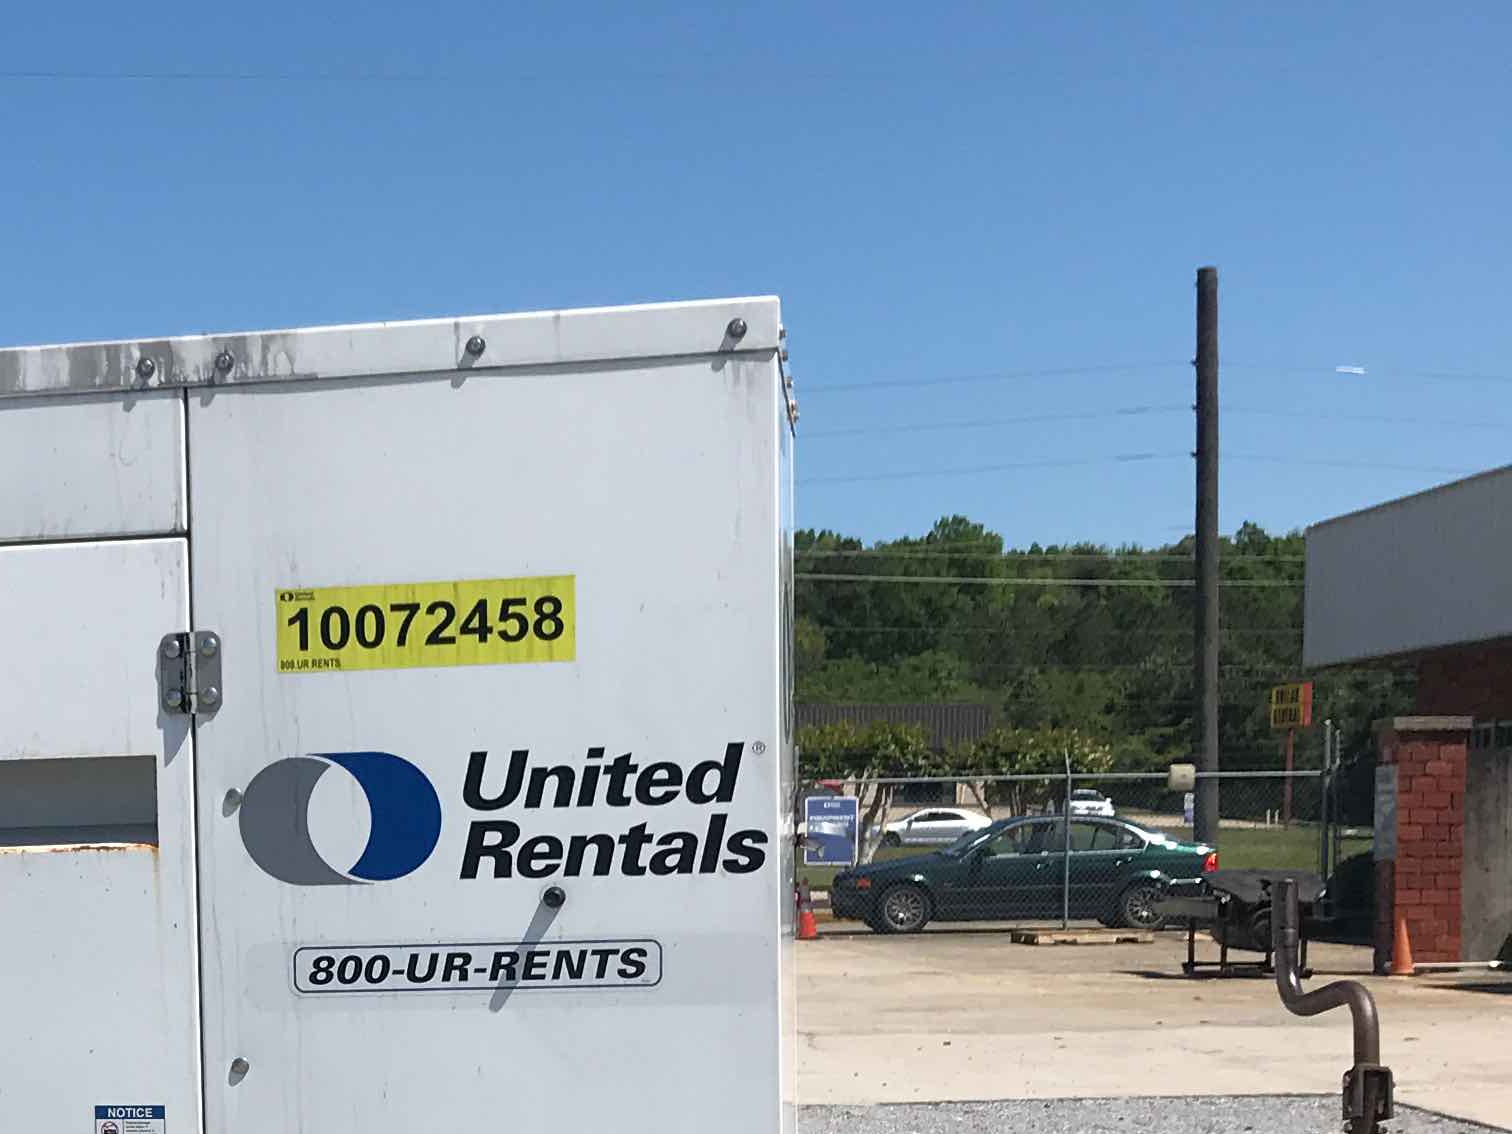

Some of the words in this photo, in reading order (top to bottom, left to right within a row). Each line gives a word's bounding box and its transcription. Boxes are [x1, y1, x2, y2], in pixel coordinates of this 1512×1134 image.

[288, 595, 565, 651] 10072458
[462, 742, 745, 812] United
[459, 813, 769, 880] Rentals
[308, 948, 648, 985] 800-UR-RENTS
[107, 1107, 153, 1118] NOTICE
